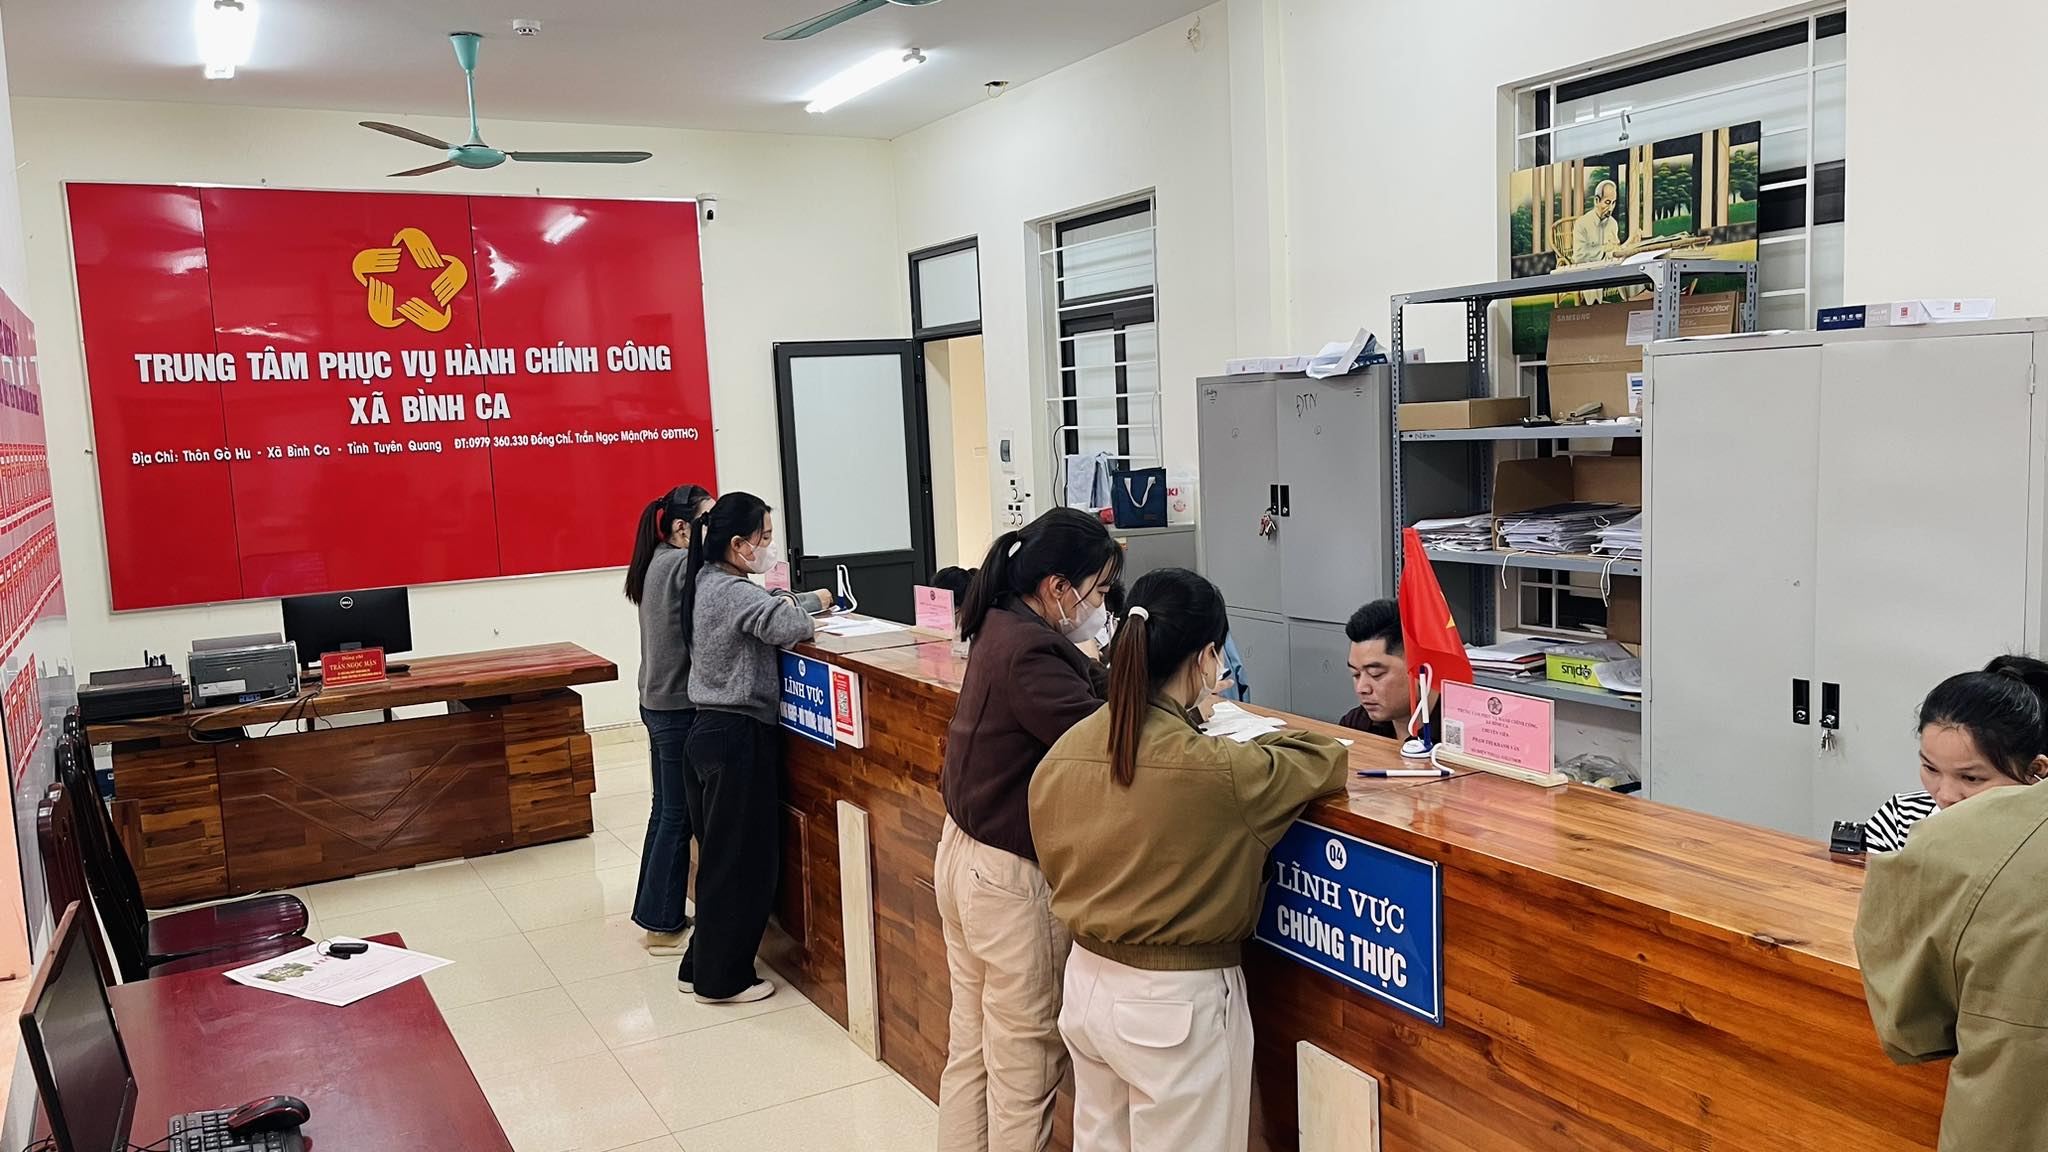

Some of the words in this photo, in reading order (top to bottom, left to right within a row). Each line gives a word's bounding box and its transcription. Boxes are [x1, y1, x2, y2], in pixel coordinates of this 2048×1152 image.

[1556, 312, 1591, 322] SAMSUNG
[1702, 304, 1730, 313] Monitor
[134, 352, 237, 383] TRUNG
[246, 345, 309, 381] TÂM
[318, 350, 393, 385] PHỤC
[401, 350, 437, 383] VỤ
[445, 343, 516, 377] HÀNH
[525, 341, 599, 374] CHÍNH
[606, 340, 672, 373] CÔNG
[348, 391, 391, 425] XÃ
[401, 387, 465, 423] BÌNH
[475, 392, 512, 420] CA
[131, 451, 152, 467] Địa
[154, 449, 179, 464] Chỉ:
[182, 448, 210, 462] Thôn
[213, 446, 232, 461] Gò
[234, 447, 252, 460] Hu
[266, 446, 283, 459] Xã
[287, 444, 310, 458] Bình
[314, 443, 331, 456] Ca
[347, 441, 370, 455] Tỉnh
[373, 439, 403, 455] Tuyên
[408, 439, 443, 453] Quang
[454, 437, 491, 449] ĐT:0979
[493, 434, 529, 447] 360.330
[595, 431, 620, 446] Ngọc
[661, 427, 699, 441] GĐTTHC)
[1561, 664, 1584, 679] plus
[806, 684, 824, 707] VỰC
[1329, 843, 1345, 865] 04
[1276, 861, 1342, 910] LĨNH
[1348, 887, 1405, 934] VỰC
[1277, 905, 1345, 962] CHỨNG
[1350, 933, 1408, 989] THỰC
